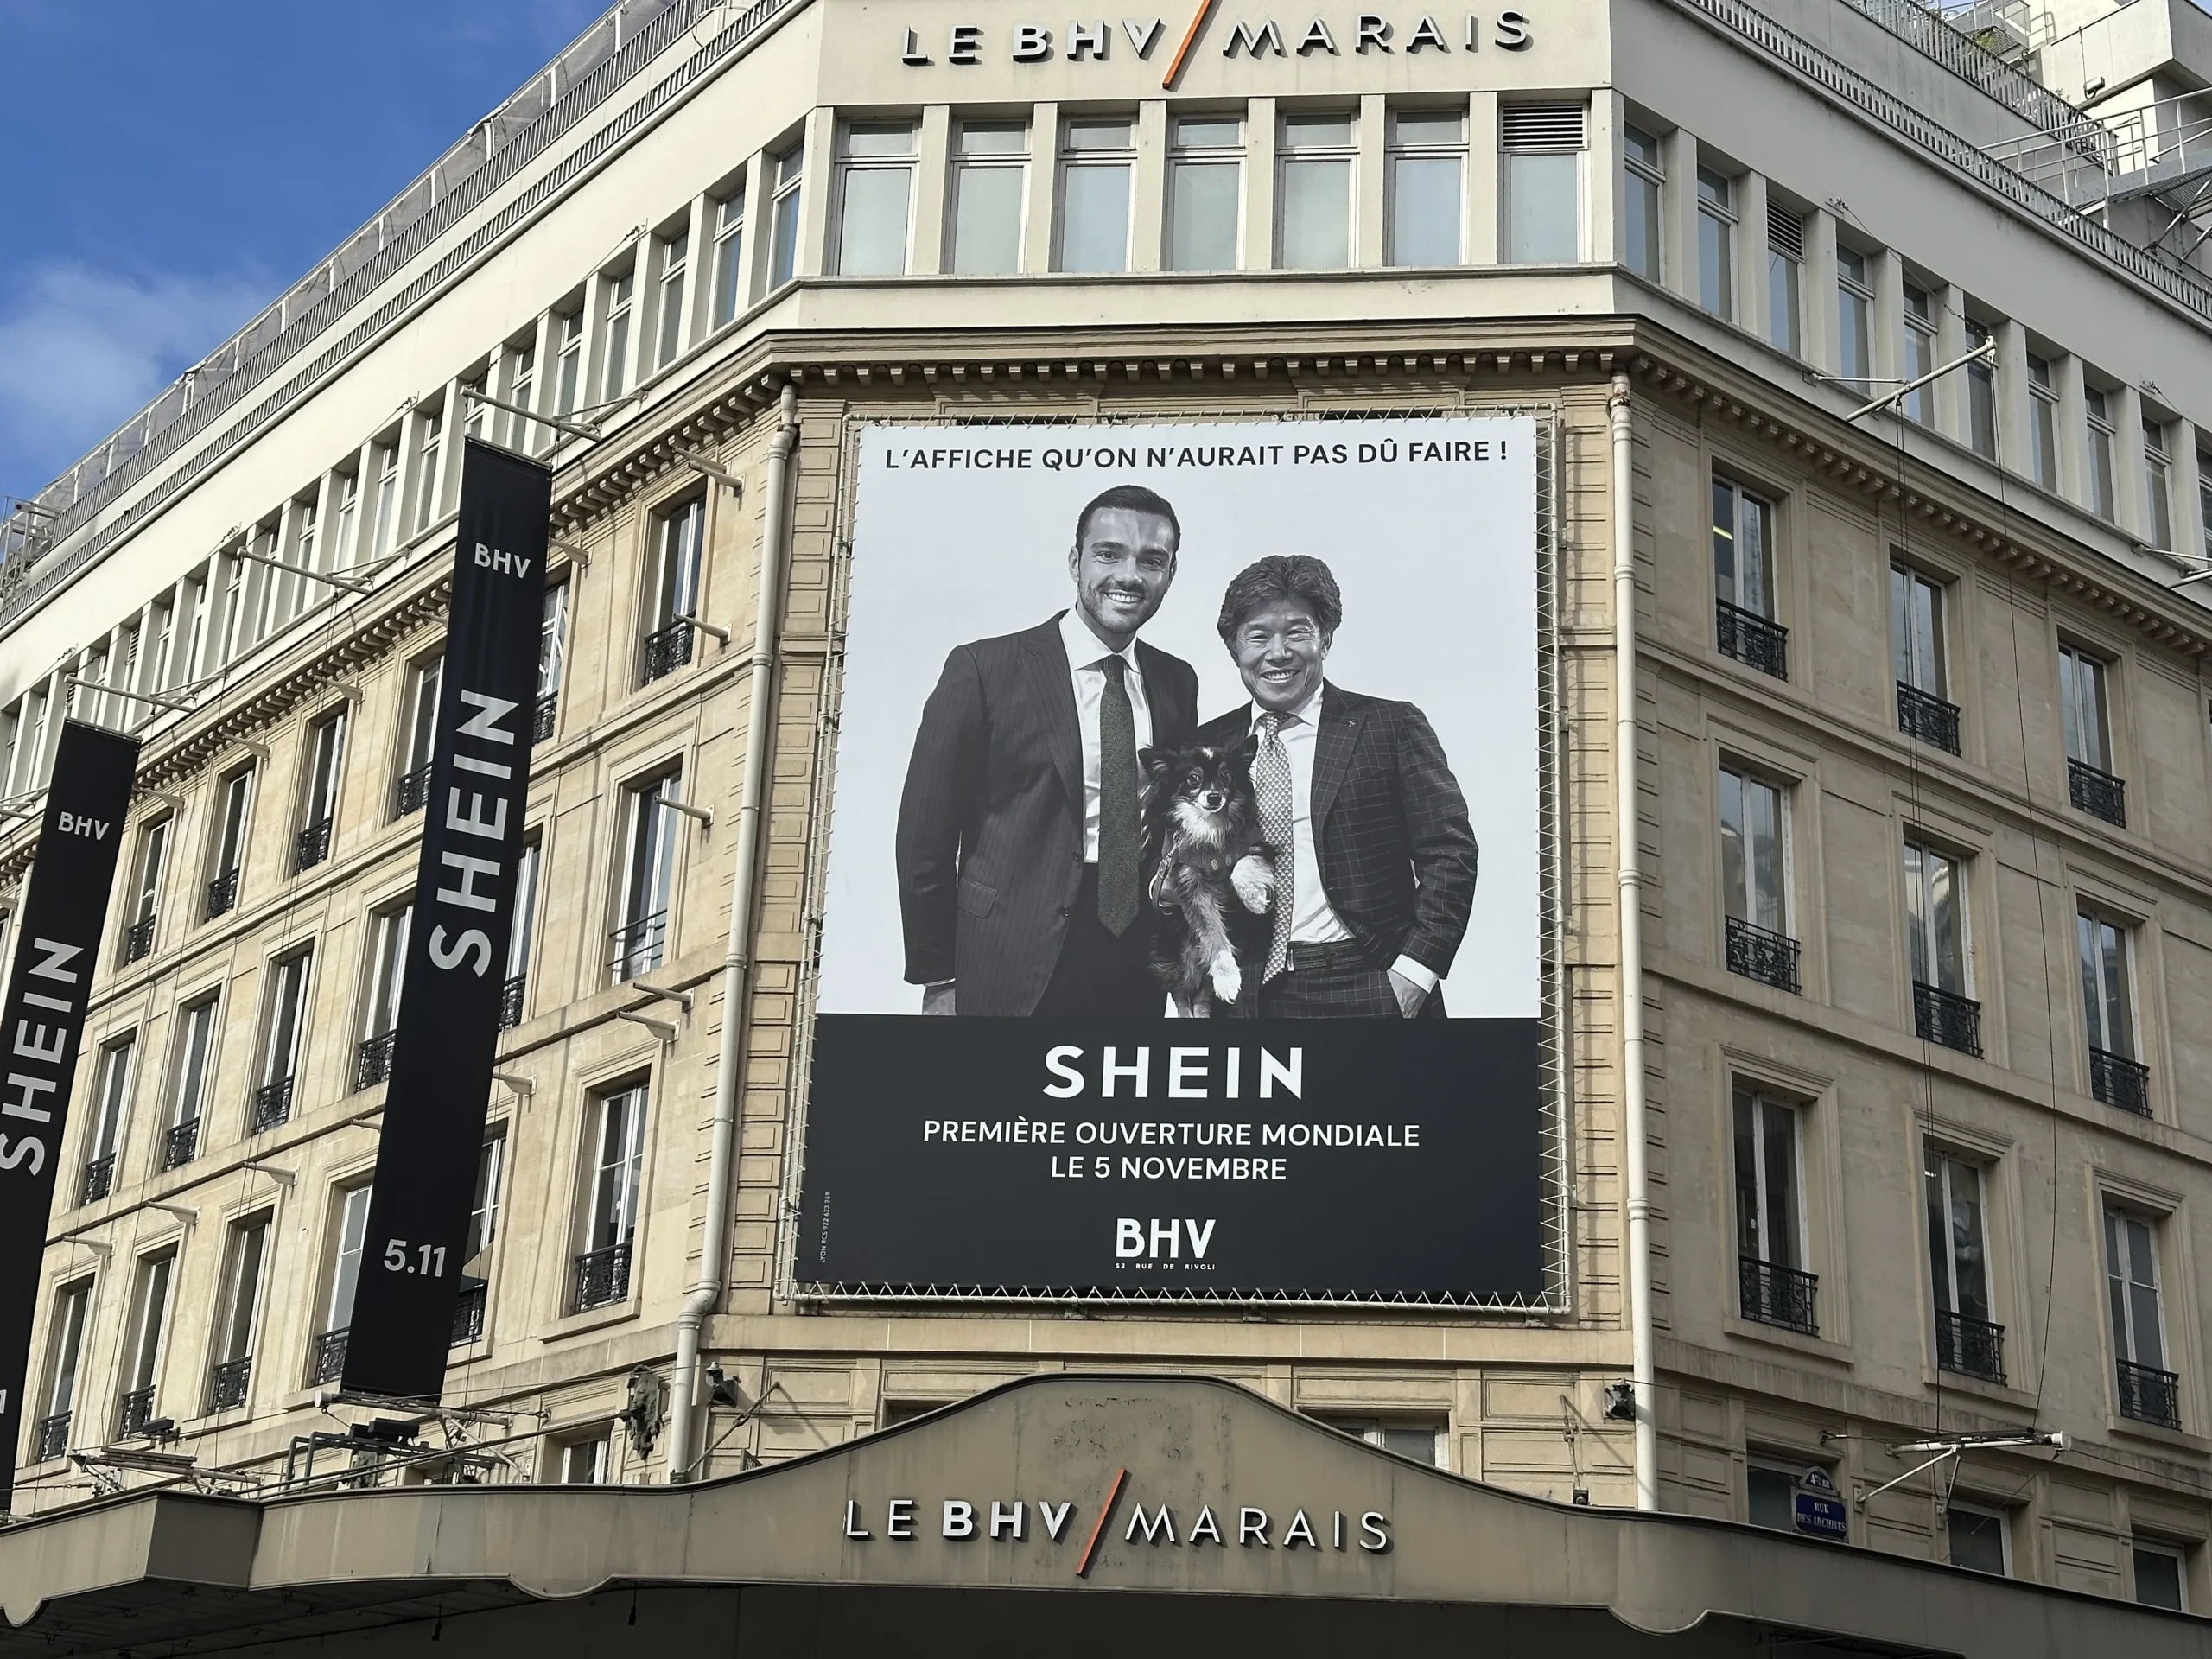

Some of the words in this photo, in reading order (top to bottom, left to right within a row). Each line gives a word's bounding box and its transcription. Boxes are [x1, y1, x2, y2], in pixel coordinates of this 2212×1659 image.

[901, 24, 978, 65] LE
[886, 448, 1033, 469] L'AFFICHE
[1042, 448, 1137, 472] QU'ON
[1147, 444, 1284, 467] N'AURAIT
[1294, 443, 1348, 465] PAS
[1358, 437, 1398, 463] DÛ
[1408, 441, 1490, 462] FAIRE
[474, 542, 531, 579] BHV
[58, 811, 110, 841] BHV
[429, 689, 519, 978] SHEIN
[0, 937, 84, 1176] SHEIN
[1042, 1045, 1305, 1100] SHEIN
[924, 1115, 1066, 1145] PREMIÈRE
[1075, 1121, 1252, 1147] OUVERTURE
[1262, 1123, 1420, 1147] MONDIALE
[1051, 1155, 1084, 1179] LE
[1094, 1156, 1110, 1179] 5
[1121, 1156, 1287, 1180] NOVEMBRE
[1116, 1217, 1217, 1259] BHV
[384, 1238, 446, 1278] 5.11
[846, 1499, 913, 1537] LE
[1797, 1513, 1812, 1525] DES
[1813, 1516, 1847, 1532] ARCHIVES
[1815, 1502, 1829, 1514] RUE
